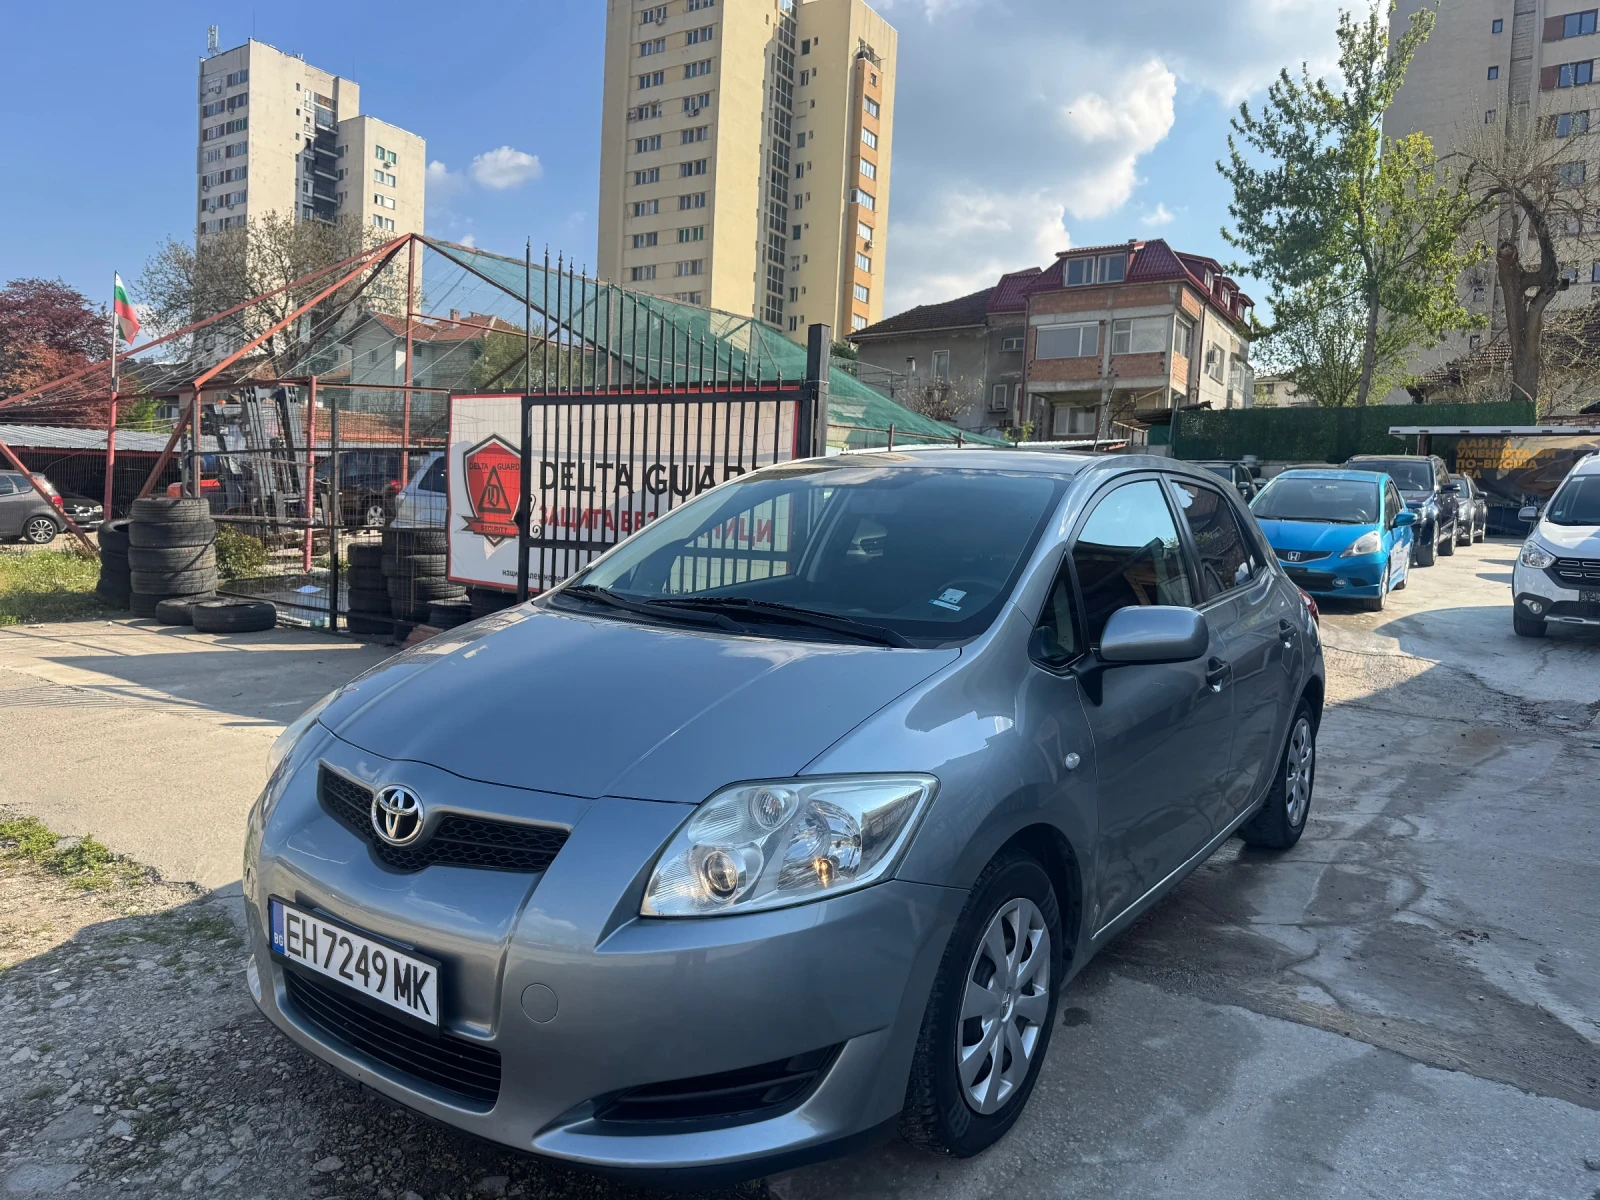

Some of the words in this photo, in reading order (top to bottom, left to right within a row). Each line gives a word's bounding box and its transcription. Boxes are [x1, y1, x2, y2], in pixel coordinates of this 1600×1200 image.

[1491, 439, 1513, 449] НА
[1456, 448, 1532, 459] УМЕНИЯТА
[469, 462, 489, 471] DELTA
[496, 463, 520, 471] GUARD
[1455, 459, 1538, 469] ПО-ВИСША
[539, 461, 635, 493] DELTA
[644, 463, 763, 497] GUA
[538, 505, 617, 533] ЗАЩИТА
[480, 524, 508, 534] SECURITY
[273, 932, 285, 947] BG
